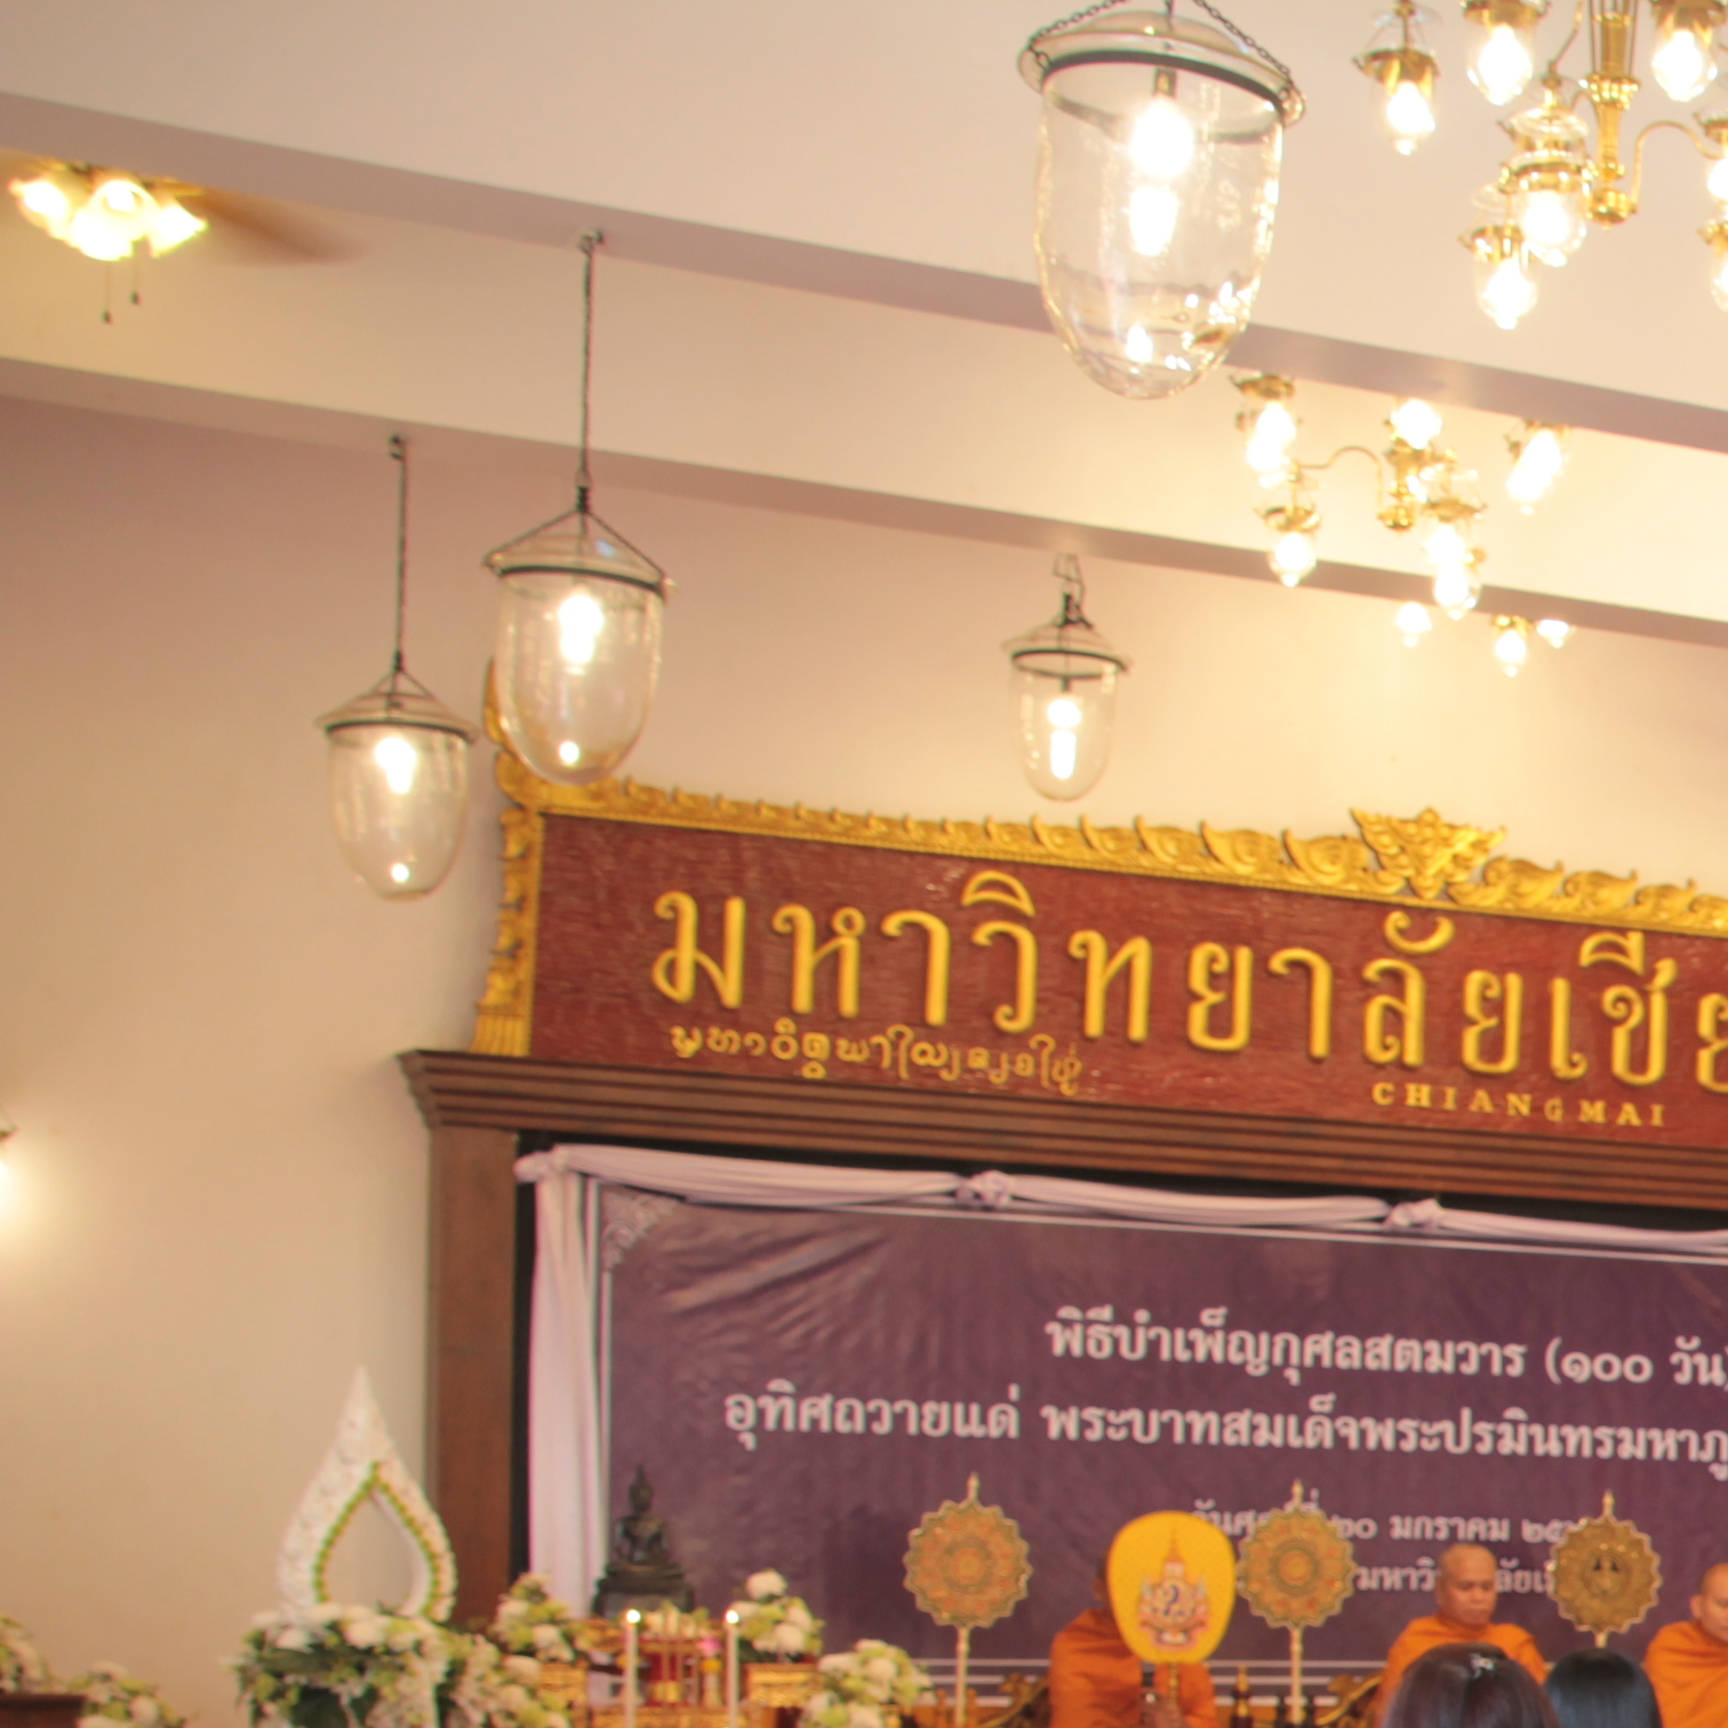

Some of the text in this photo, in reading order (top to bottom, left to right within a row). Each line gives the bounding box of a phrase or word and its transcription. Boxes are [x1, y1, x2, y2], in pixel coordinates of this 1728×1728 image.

[1045, 1304, 1527, 1386] พิธีบำเพ็ญกุศลสตมวาร
[1545, 1336, 1653, 1384] (๑๐๐
[724, 1378, 1020, 1450] อุทิศถวายแด่
[1389, 1514, 1510, 1542] มกราคม
